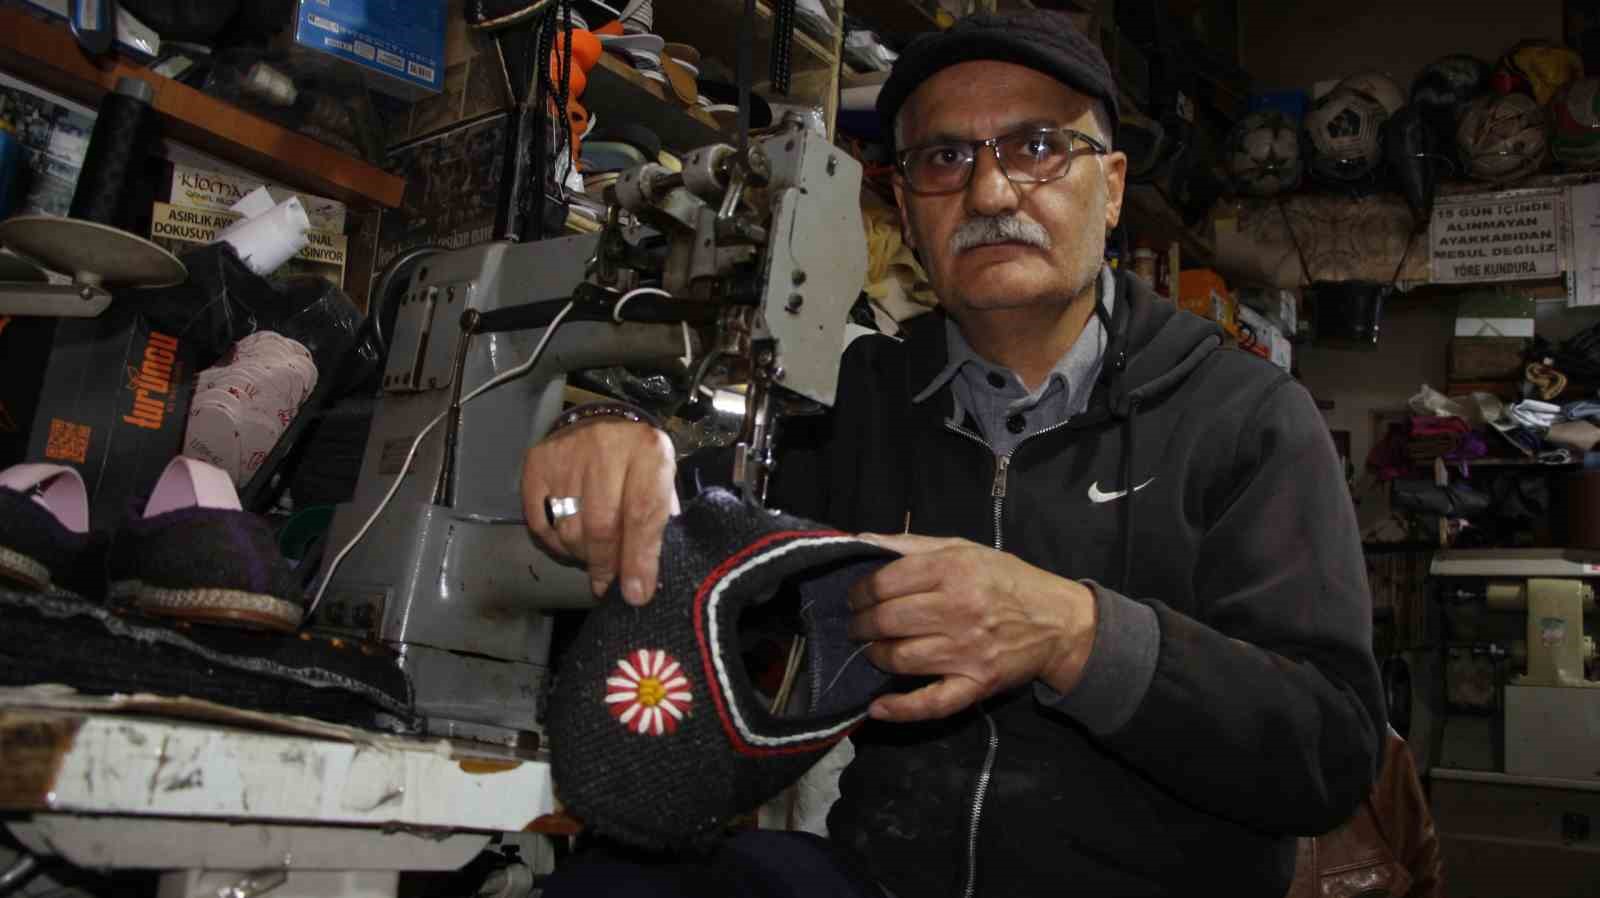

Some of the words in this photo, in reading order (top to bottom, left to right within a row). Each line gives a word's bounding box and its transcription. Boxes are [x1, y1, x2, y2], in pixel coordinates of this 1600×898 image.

[168, 208, 213, 226] ASIRLIK
[1438, 208, 1454, 218] 15
[1459, 205, 1493, 218] GÜN
[1497, 200, 1553, 216] İÇİNDE
[1446, 216, 1537, 232] ALINMAYAN
[1439, 230, 1552, 245] AYAKKABIDAN
[1433, 249, 1487, 259] MESUL
[1453, 263, 1481, 277] YÖRE
[1484, 261, 1537, 275] KUNDURA
